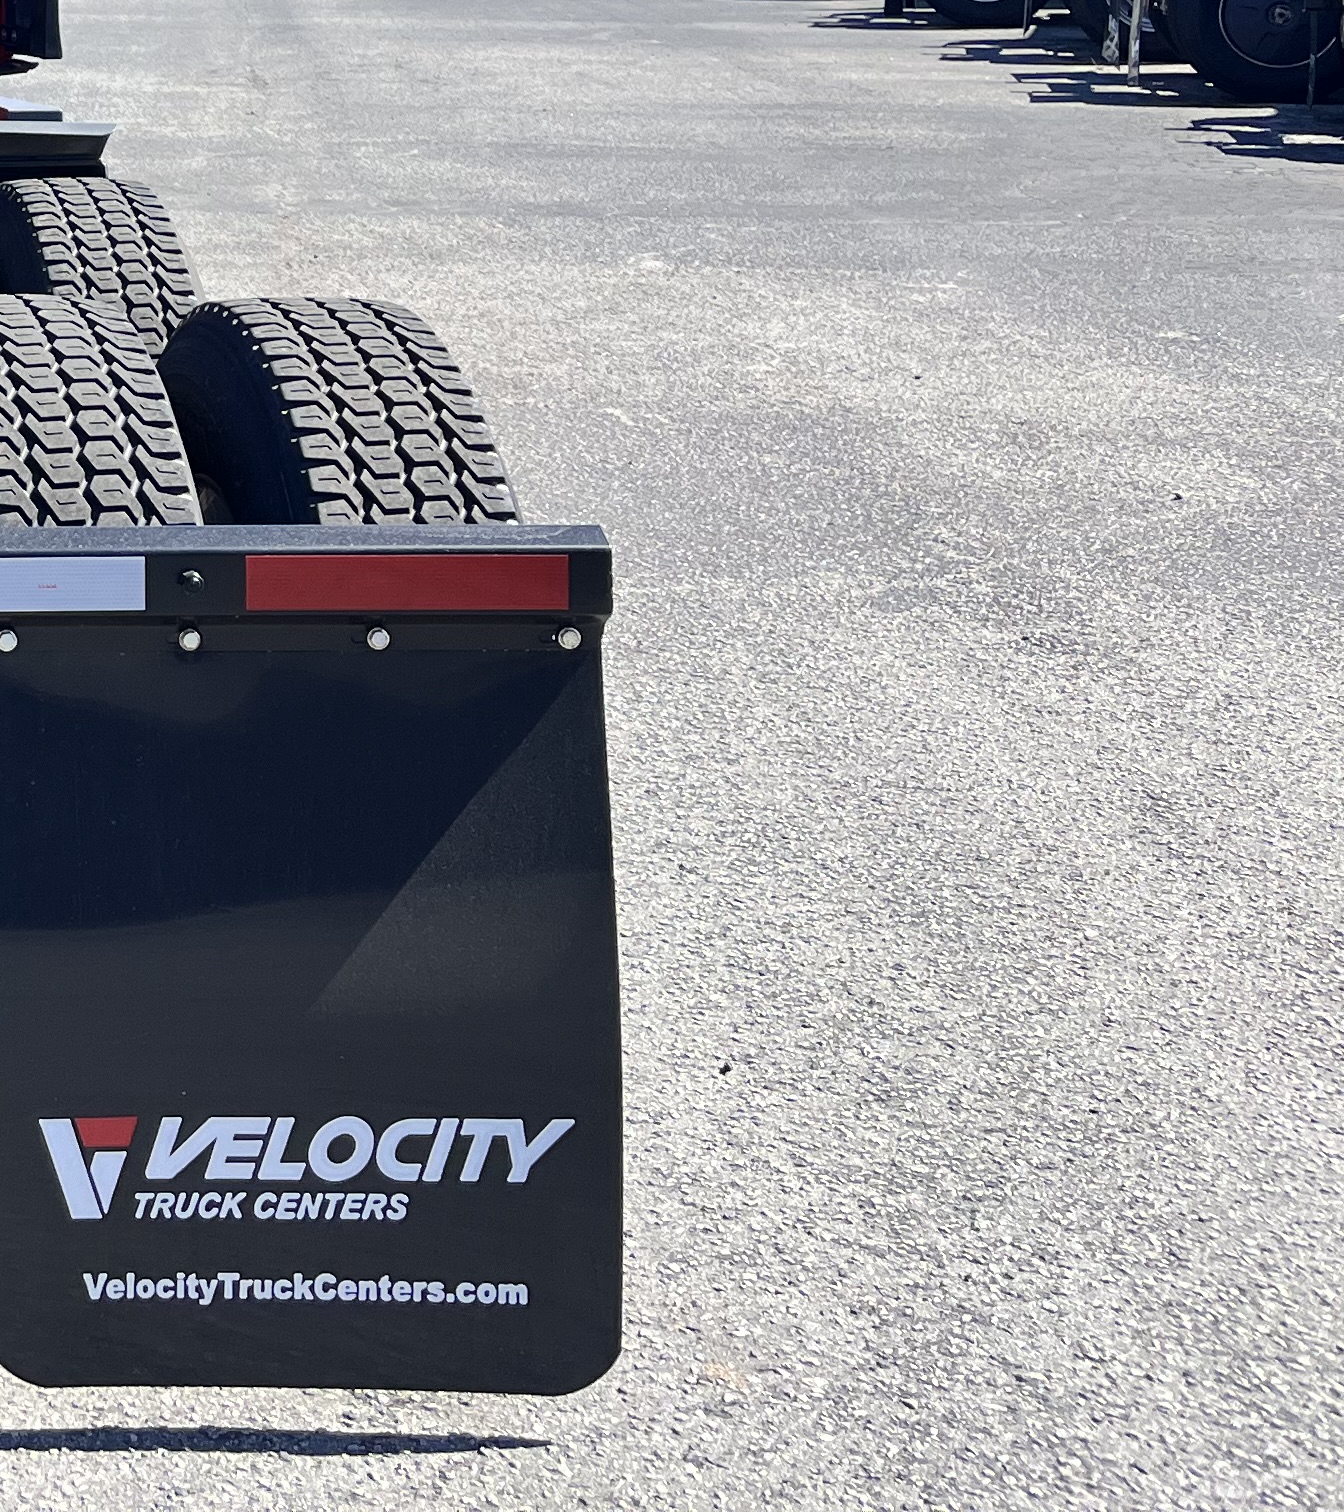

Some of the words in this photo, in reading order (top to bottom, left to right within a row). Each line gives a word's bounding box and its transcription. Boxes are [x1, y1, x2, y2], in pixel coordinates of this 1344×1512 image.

[145, 1116, 576, 1183] VELOCITY
[135, 1192, 246, 1220] TRUCK
[254, 1192, 409, 1221] CENTERS
[83, 1272, 529, 1306] VelocityTruckCenters.com
